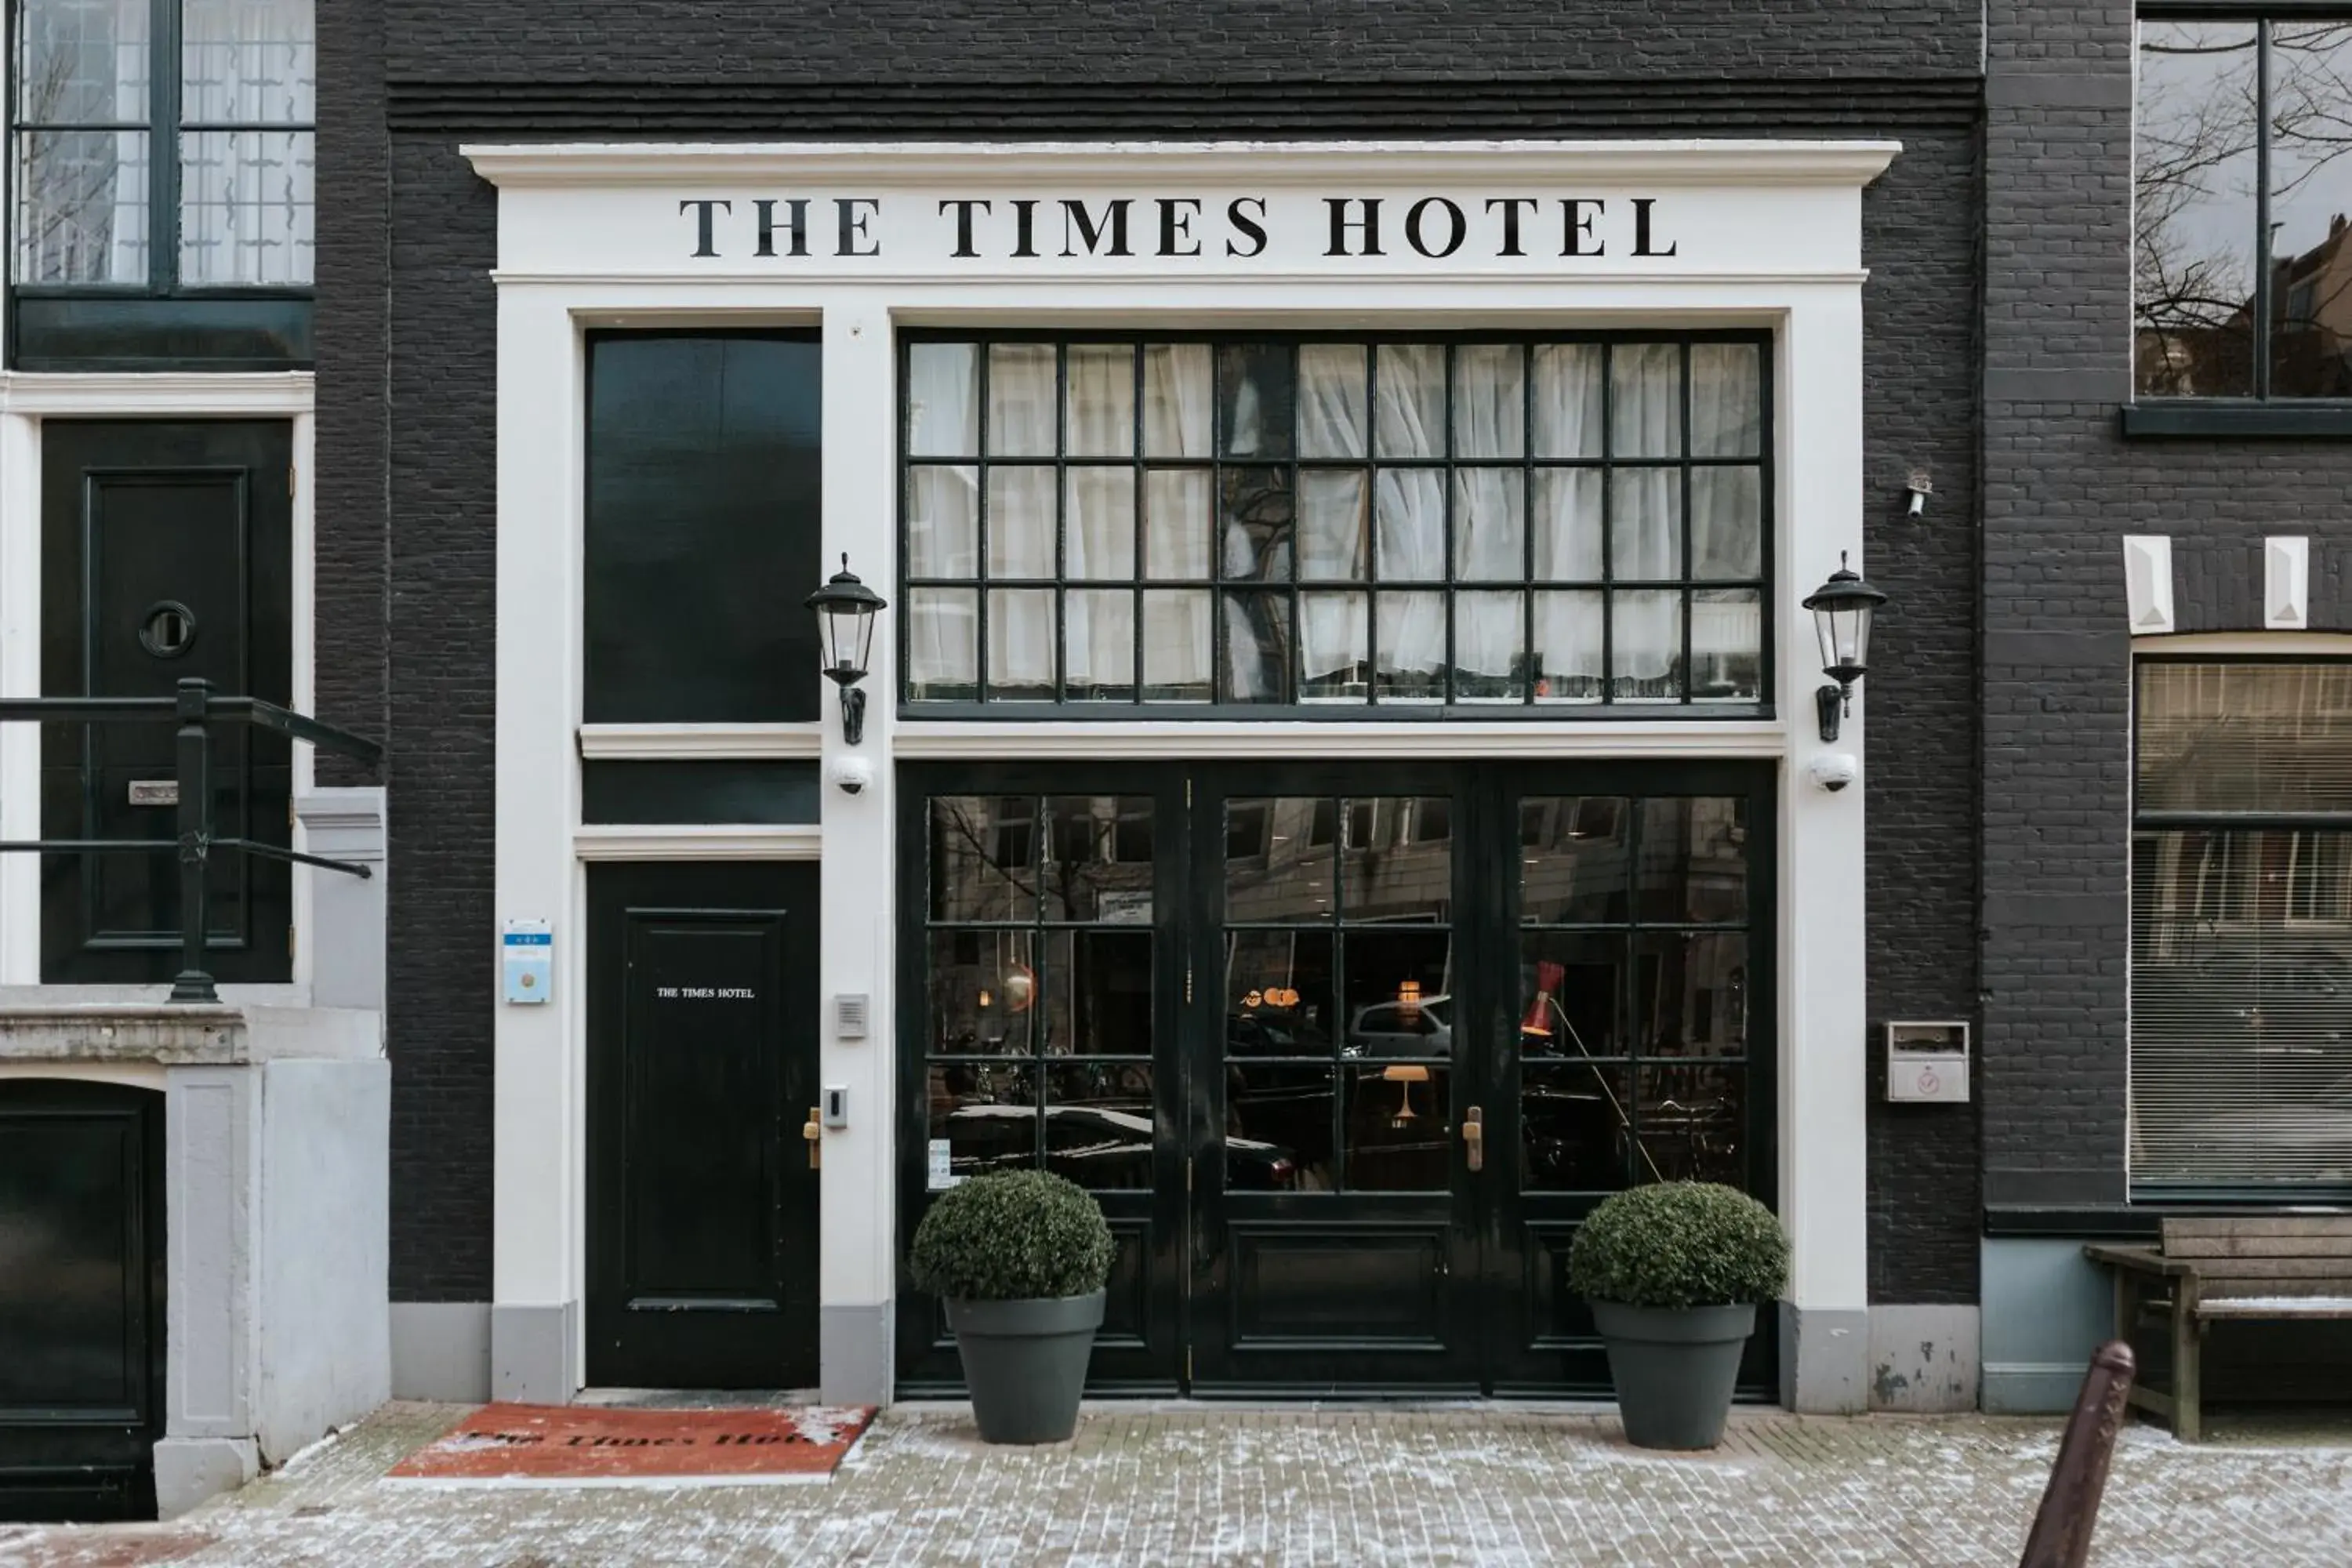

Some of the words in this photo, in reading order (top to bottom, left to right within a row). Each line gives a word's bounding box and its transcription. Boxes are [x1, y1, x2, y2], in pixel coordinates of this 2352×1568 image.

[679, 199, 880, 256] THE
[938, 198, 1269, 257] TIMES
[1322, 198, 1677, 257] HOTEL
[657, 987, 678, 998] THE
[681, 987, 715, 998] TIMES
[717, 988, 755, 999] HOTEL
[714, 1432, 840, 1446] Hot
